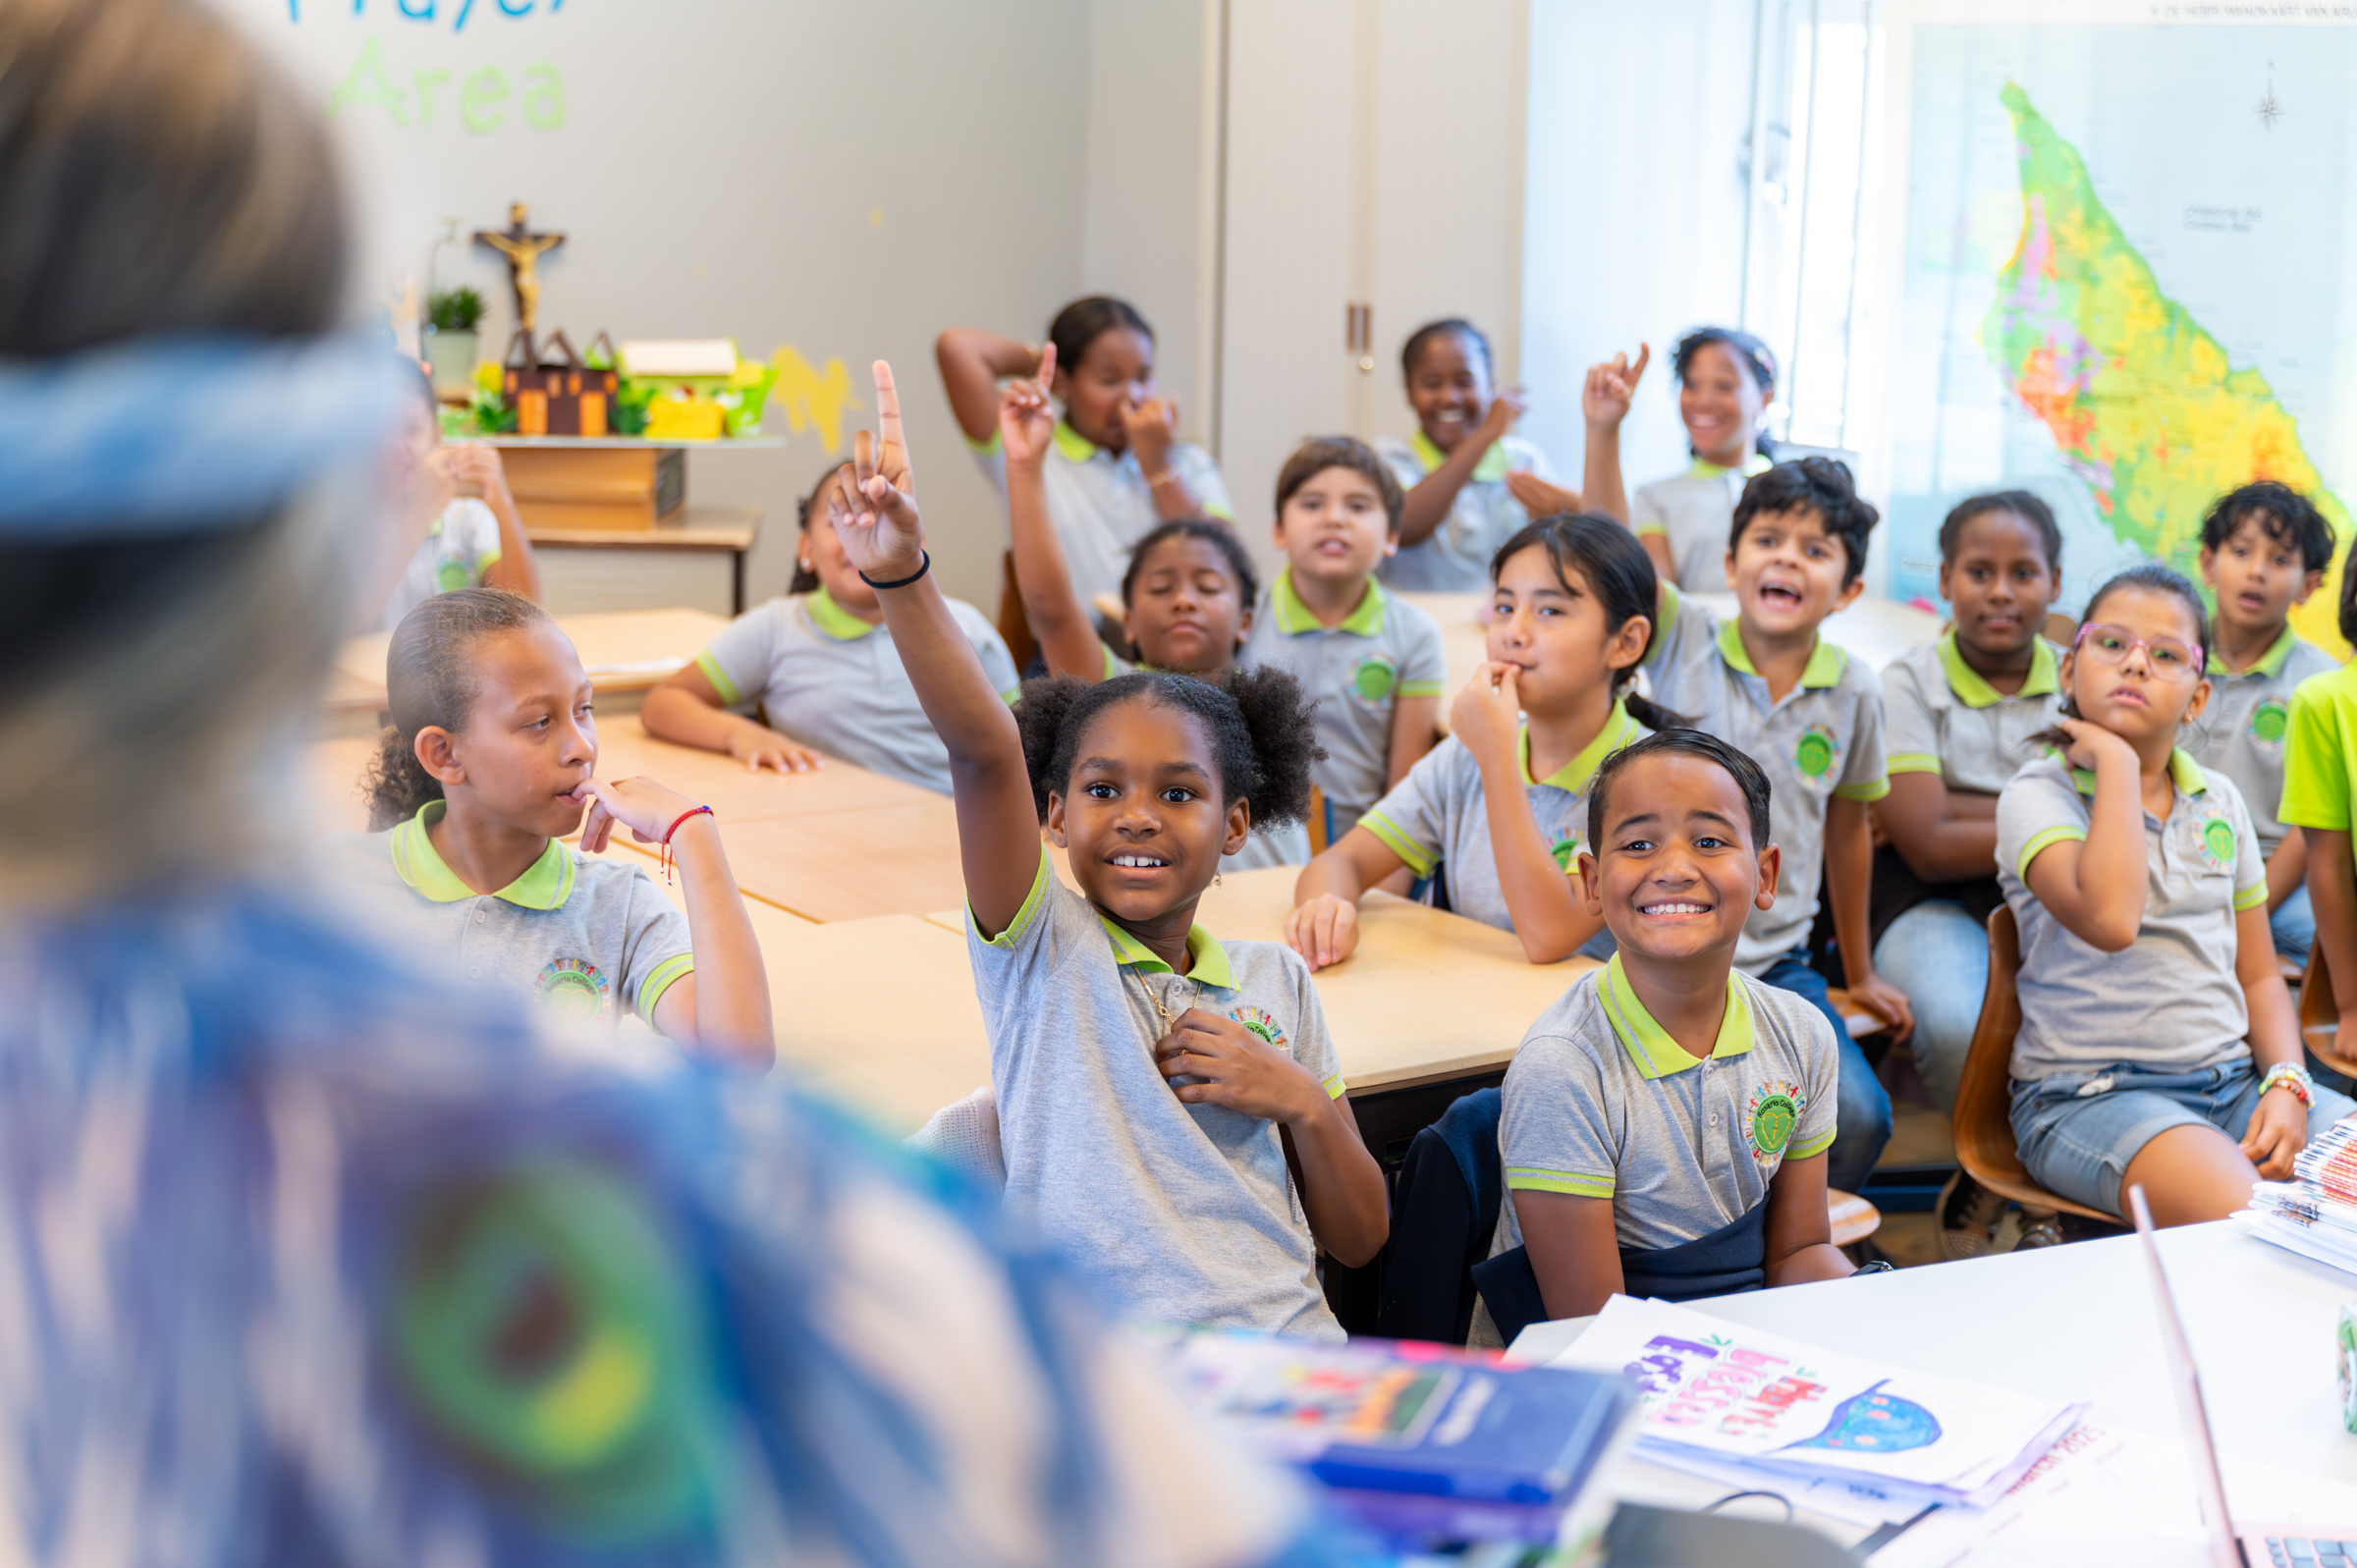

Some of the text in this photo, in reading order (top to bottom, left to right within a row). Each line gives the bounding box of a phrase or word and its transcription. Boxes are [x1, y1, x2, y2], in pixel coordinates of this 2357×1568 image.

[326, 35, 567, 135] Area
[545, 976, 597, 996] Rosario College
[1757, 1100, 1779, 1118] Rosario
[2053, 1426, 2107, 1455] 2025
